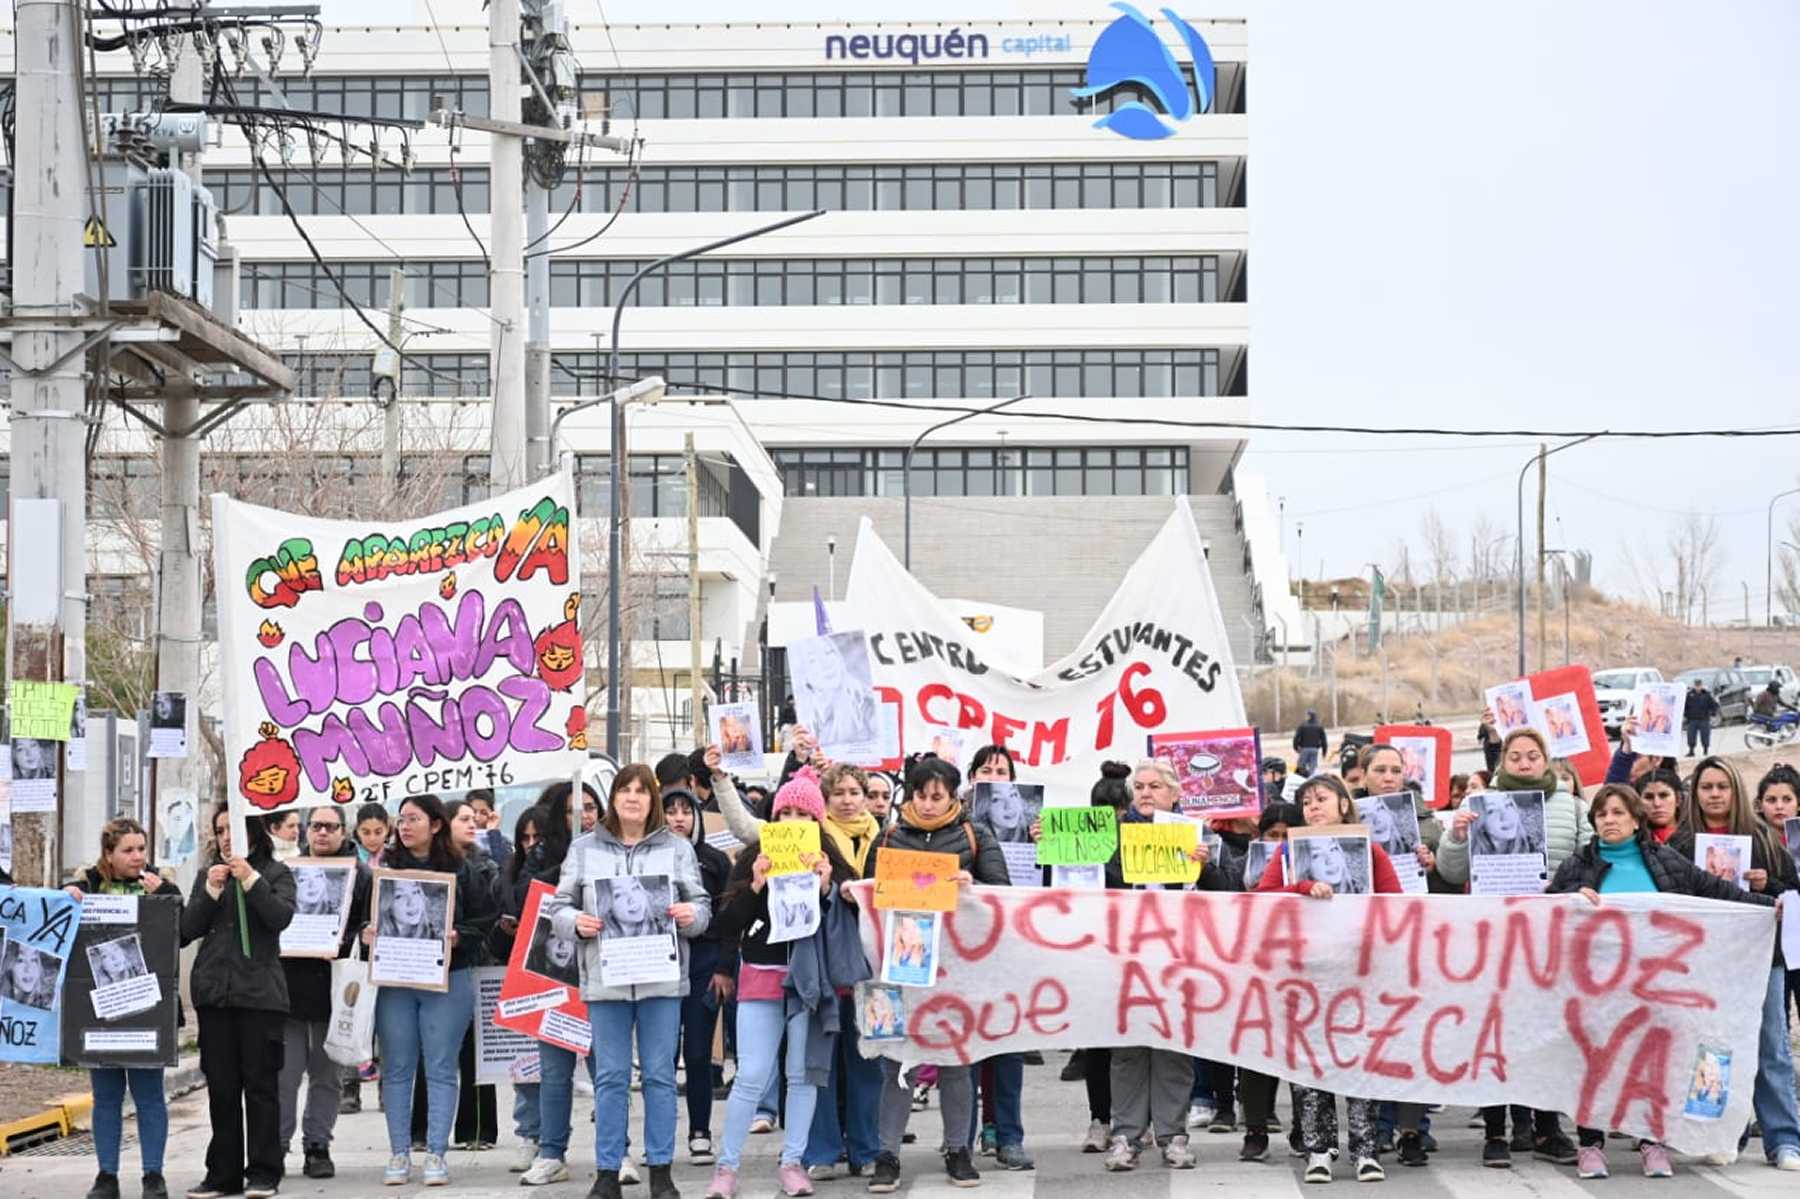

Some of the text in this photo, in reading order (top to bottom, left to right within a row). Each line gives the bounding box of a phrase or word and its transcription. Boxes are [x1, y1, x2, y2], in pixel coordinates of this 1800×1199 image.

[826, 28, 1072, 64] neuquén capital
[246, 496, 569, 608] QUE APAREZCA YA
[292, 675, 566, 792] MUÑOZ
[405, 765, 473, 795] CPEM
[1050, 809, 1071, 834] NI
[1078, 809, 1108, 834] UNA
[27, 898, 74, 953] YA
[1357, 894, 1717, 1010] MUÑOZ
[1564, 997, 1674, 1140] YA
